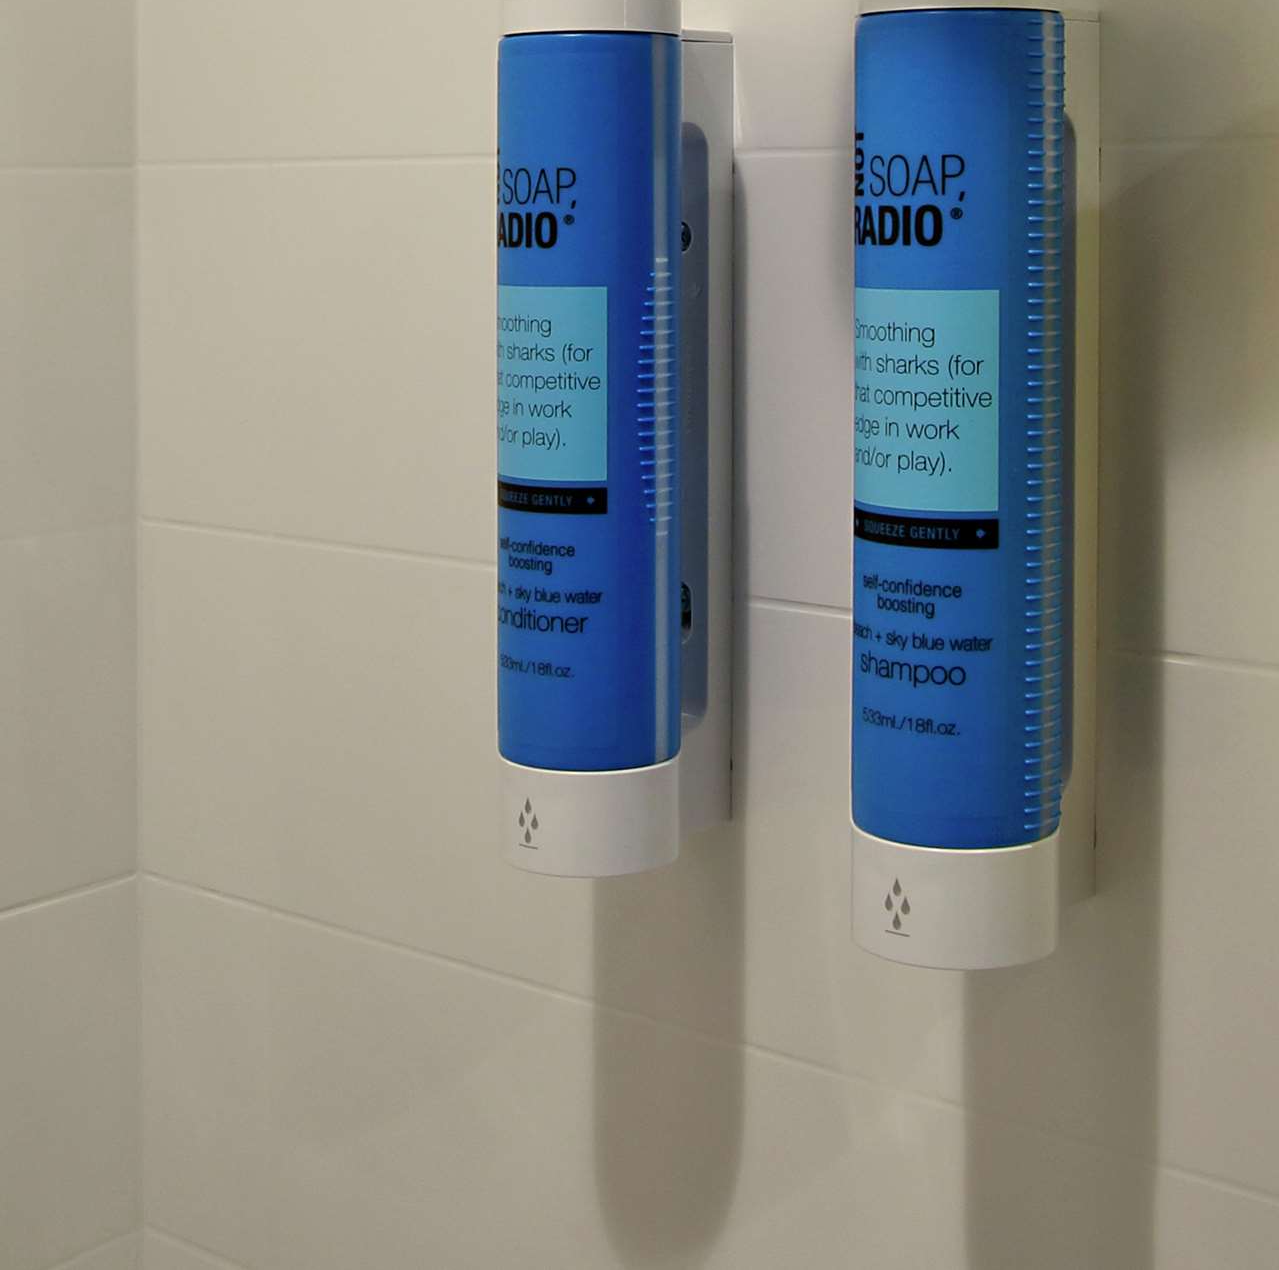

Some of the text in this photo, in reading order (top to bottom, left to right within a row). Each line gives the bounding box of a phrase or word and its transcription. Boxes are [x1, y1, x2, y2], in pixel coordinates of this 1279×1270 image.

[502, 167, 577, 209] SOAP,
[869, 153, 966, 203] SOAP,
[506, 343, 556, 362] sharks
[562, 342, 594, 365] (for
[875, 353, 940, 376] sharks
[948, 354, 985, 380] (for
[505, 372, 601, 392] competitive
[513, 399, 524, 416] in
[528, 400, 573, 419] work
[873, 386, 993, 411] competitive
[522, 427, 567, 450] play).
[885, 416, 900, 437] in
[905, 418, 960, 440] work
[897, 450, 952, 477] play).
[531, 493, 574, 507] GENTLY
[910, 526, 960, 541] GENTLY
[508, 554, 553, 576] boosting
[534, 586, 561, 603] blue
[564, 589, 604, 604] water
[863, 574, 963, 599] self-confidence
[877, 594, 935, 619] boosting
[497, 606, 589, 634] onditioner
[885, 630, 908, 651] sky
[912, 632, 945, 651] blue
[949, 635, 993, 652] water
[860, 649, 967, 688] shampoo
